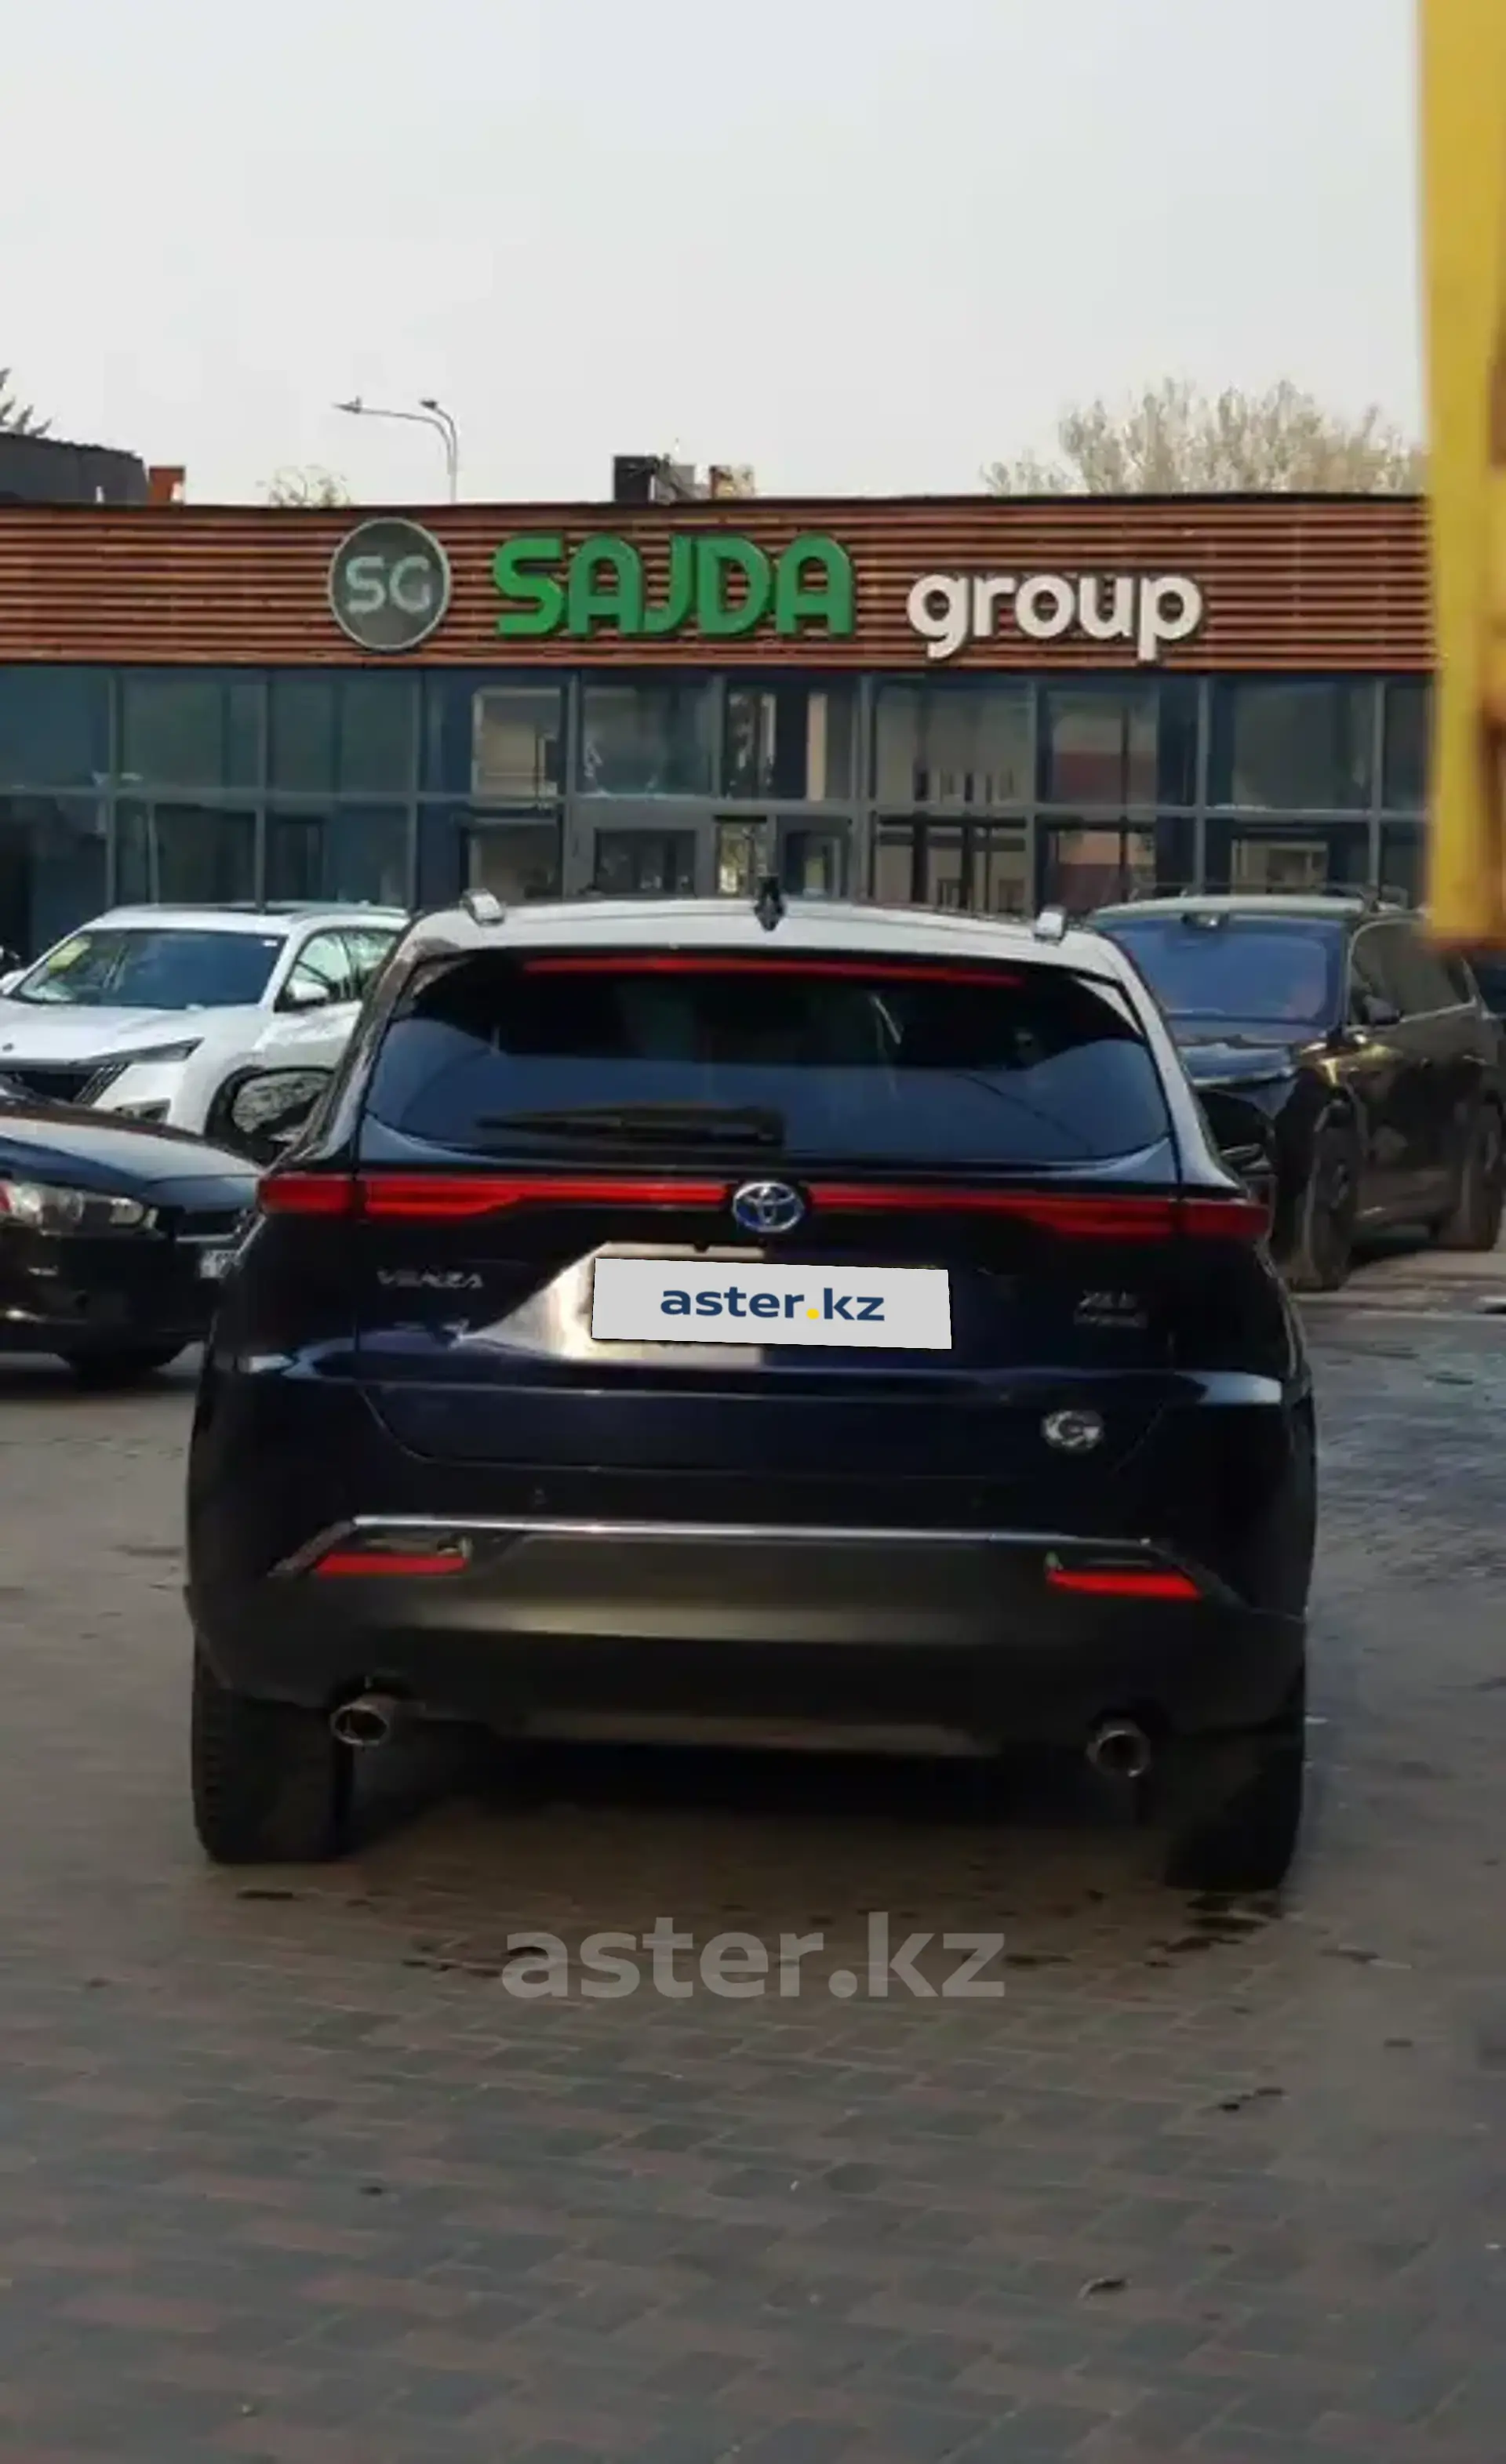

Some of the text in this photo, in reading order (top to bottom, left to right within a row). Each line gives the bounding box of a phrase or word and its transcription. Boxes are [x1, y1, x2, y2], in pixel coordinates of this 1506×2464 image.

[346, 555, 431, 613] SG
[492, 532, 1202, 661] SAJDA group
